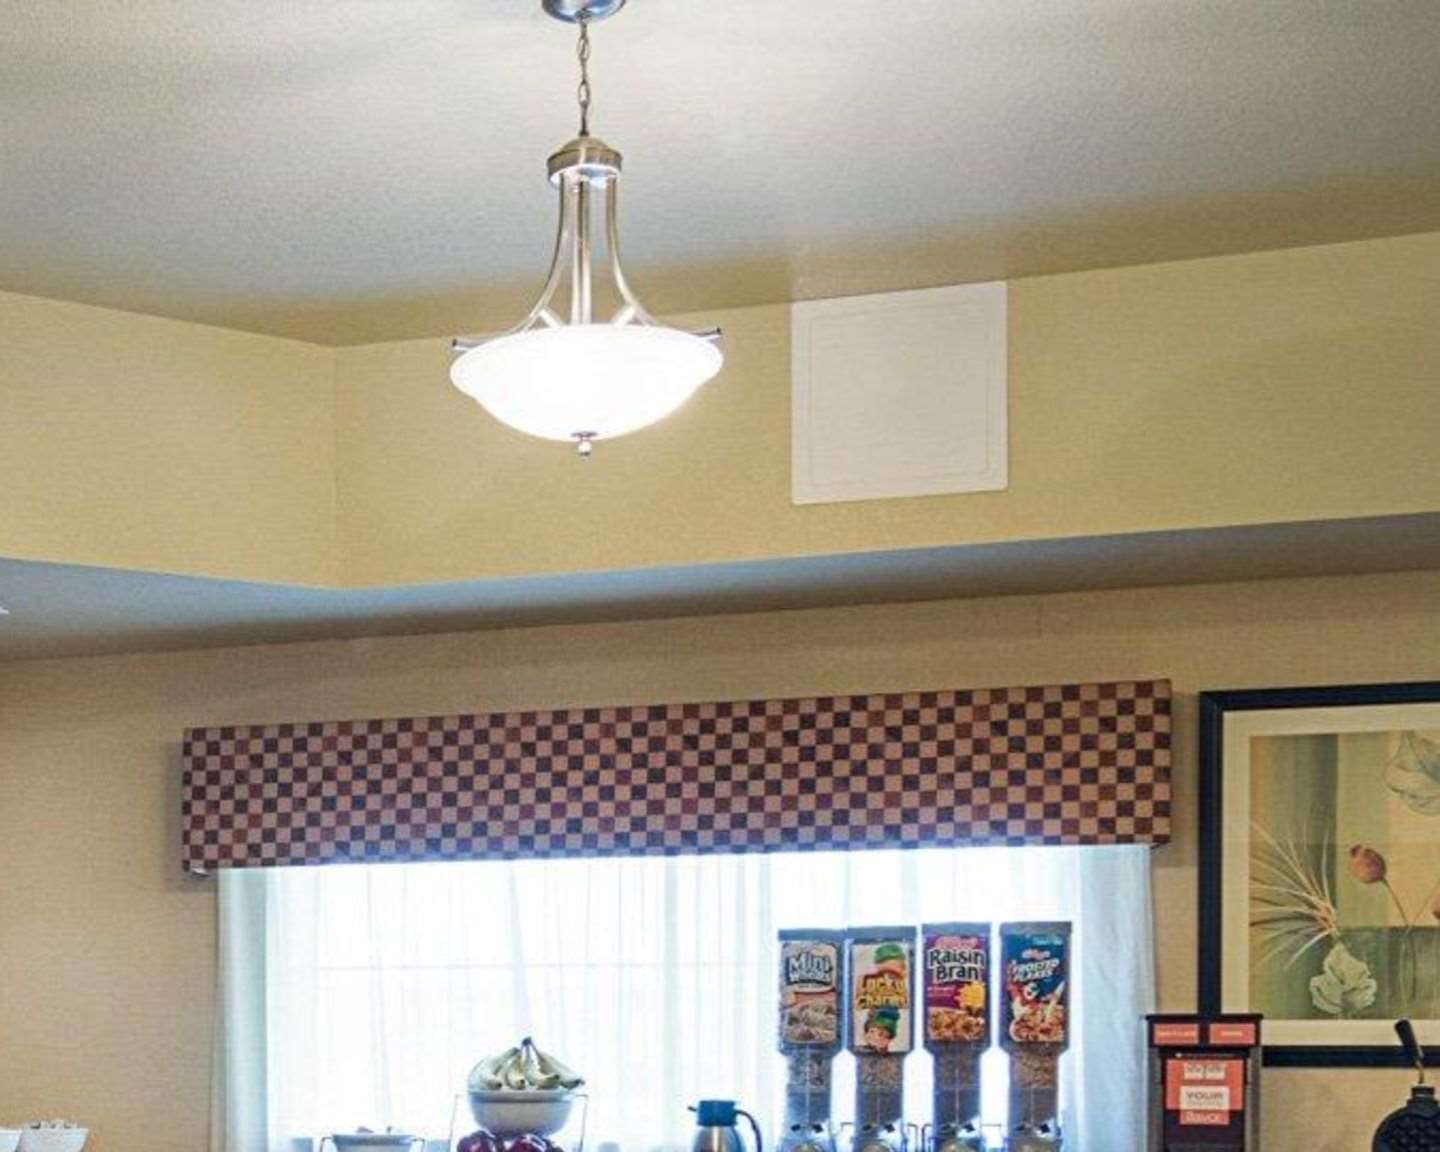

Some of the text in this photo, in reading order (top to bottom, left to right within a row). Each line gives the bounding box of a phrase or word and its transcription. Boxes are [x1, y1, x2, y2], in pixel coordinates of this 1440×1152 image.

[929, 950, 985, 967] Raisin
[936, 964, 979, 981] Bran
[1186, 1091, 1224, 1100] YOUR
